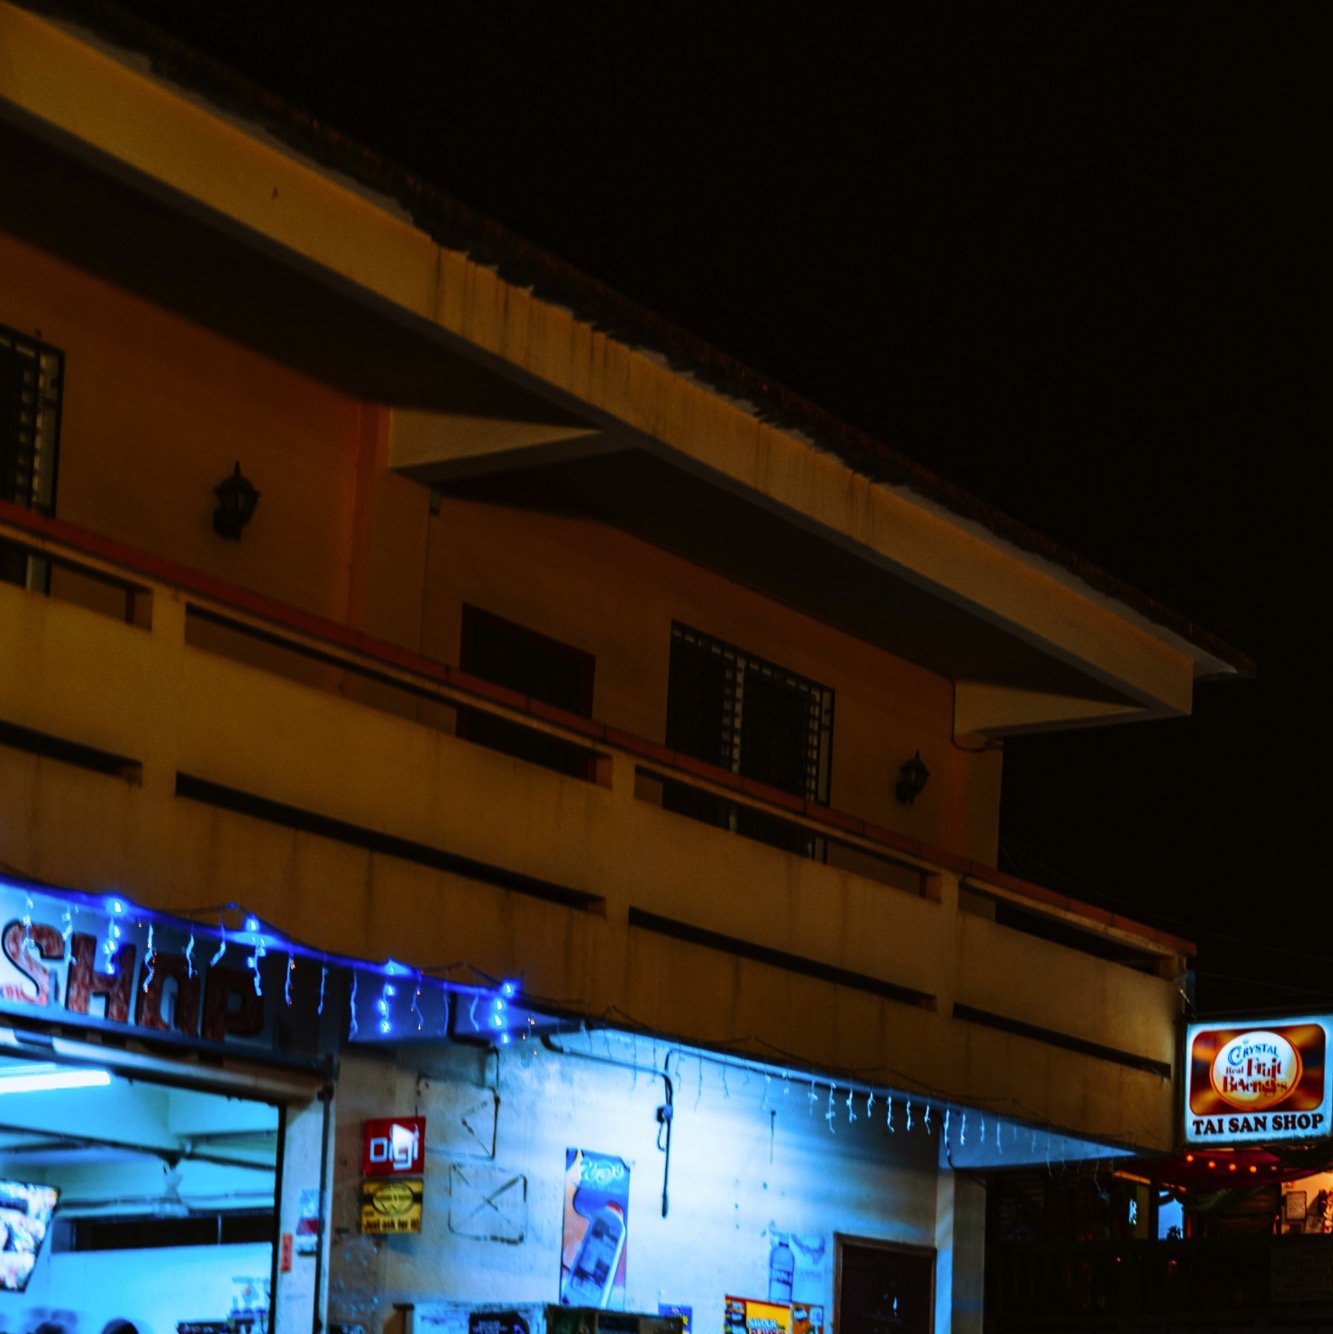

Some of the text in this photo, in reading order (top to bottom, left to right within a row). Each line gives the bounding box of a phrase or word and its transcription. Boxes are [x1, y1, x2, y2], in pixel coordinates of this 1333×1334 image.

[2, 921, 264, 1042] SHOP
[1247, 1057, 1282, 1080] Fruit
[1193, 1113, 1324, 1135] TAI SAN SHOP
